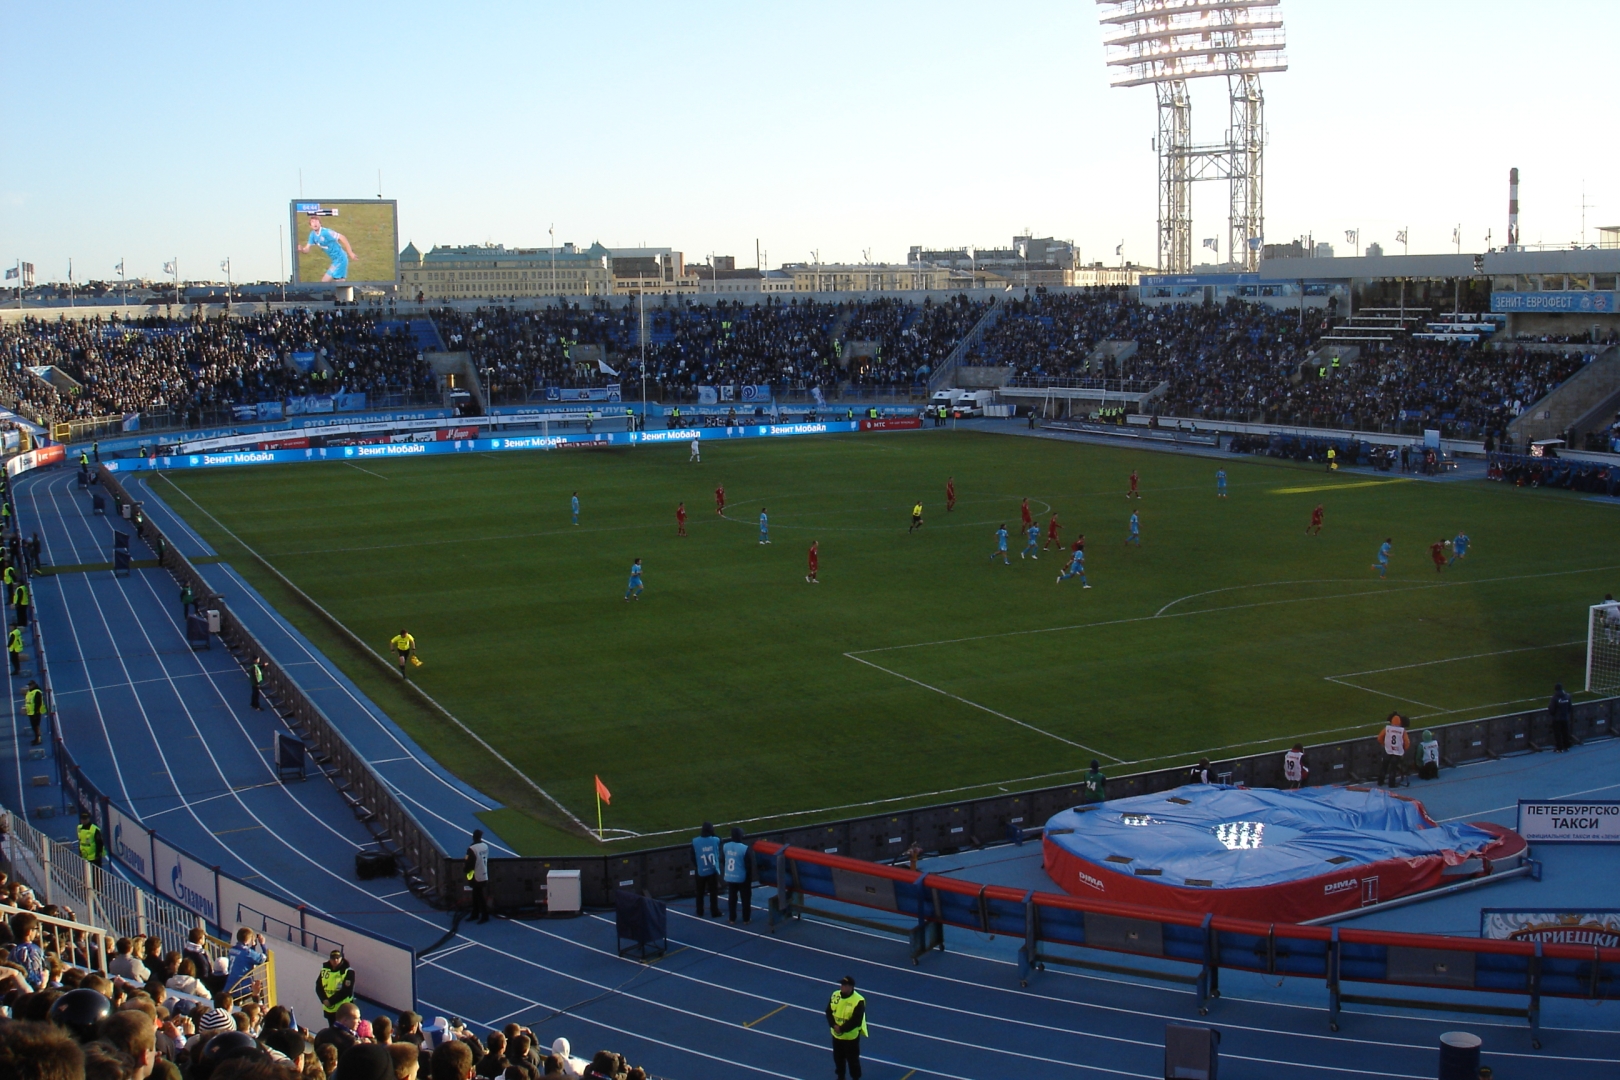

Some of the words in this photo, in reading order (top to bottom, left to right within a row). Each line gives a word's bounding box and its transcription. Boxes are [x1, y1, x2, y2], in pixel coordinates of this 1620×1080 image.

[641, 431, 667, 441] Зенит
[667, 429, 701, 439] Мобайл
[771, 425, 793, 434] Зенит
[795, 423, 827, 433] Мобайл
[504, 438, 530, 449] Зенит
[531, 436, 567, 447] Мобайл
[358, 446, 387, 457] Зенит
[387, 444, 425, 456] Мобайл
[204, 455, 233, 466] Зенит
[234, 452, 275, 464] Мобайл
[1391, 734, 1397, 745] 8
[1286, 759, 1295, 770] 19
[1527, 805, 1619, 816] ПЕТЕРБУРГСКО
[1551, 817, 1599, 829] ТАКСИ
[122, 851, 145, 876] ГАЗПРОМ
[728, 857, 735, 871] 8
[1078, 870, 1104, 888] DIMA
[1324, 878, 1358, 892] DIMA
[184, 888, 215, 922] ГАЗПРОМ
